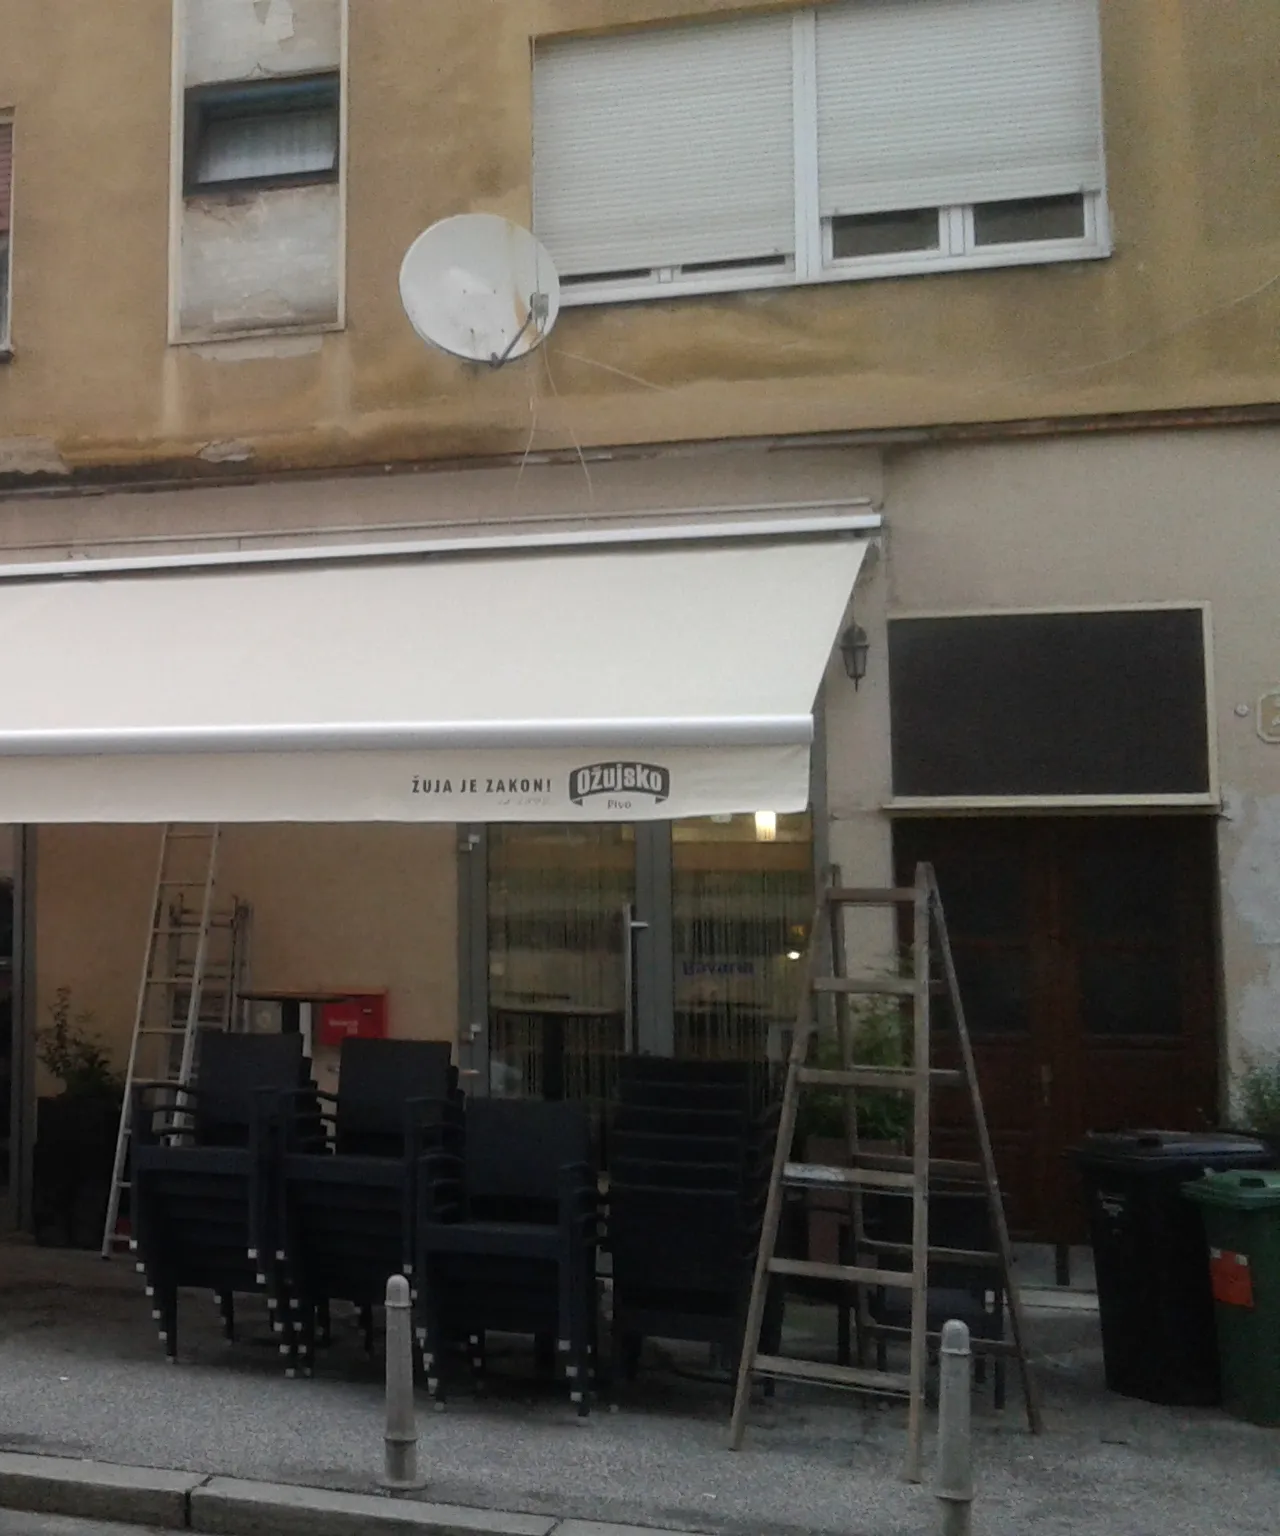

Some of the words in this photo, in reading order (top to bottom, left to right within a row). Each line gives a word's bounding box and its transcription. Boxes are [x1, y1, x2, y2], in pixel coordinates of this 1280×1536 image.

[411, 775, 453, 793] ŽUJA
[460, 778, 478, 793] JE
[486, 778, 552, 793] ZAKON!
